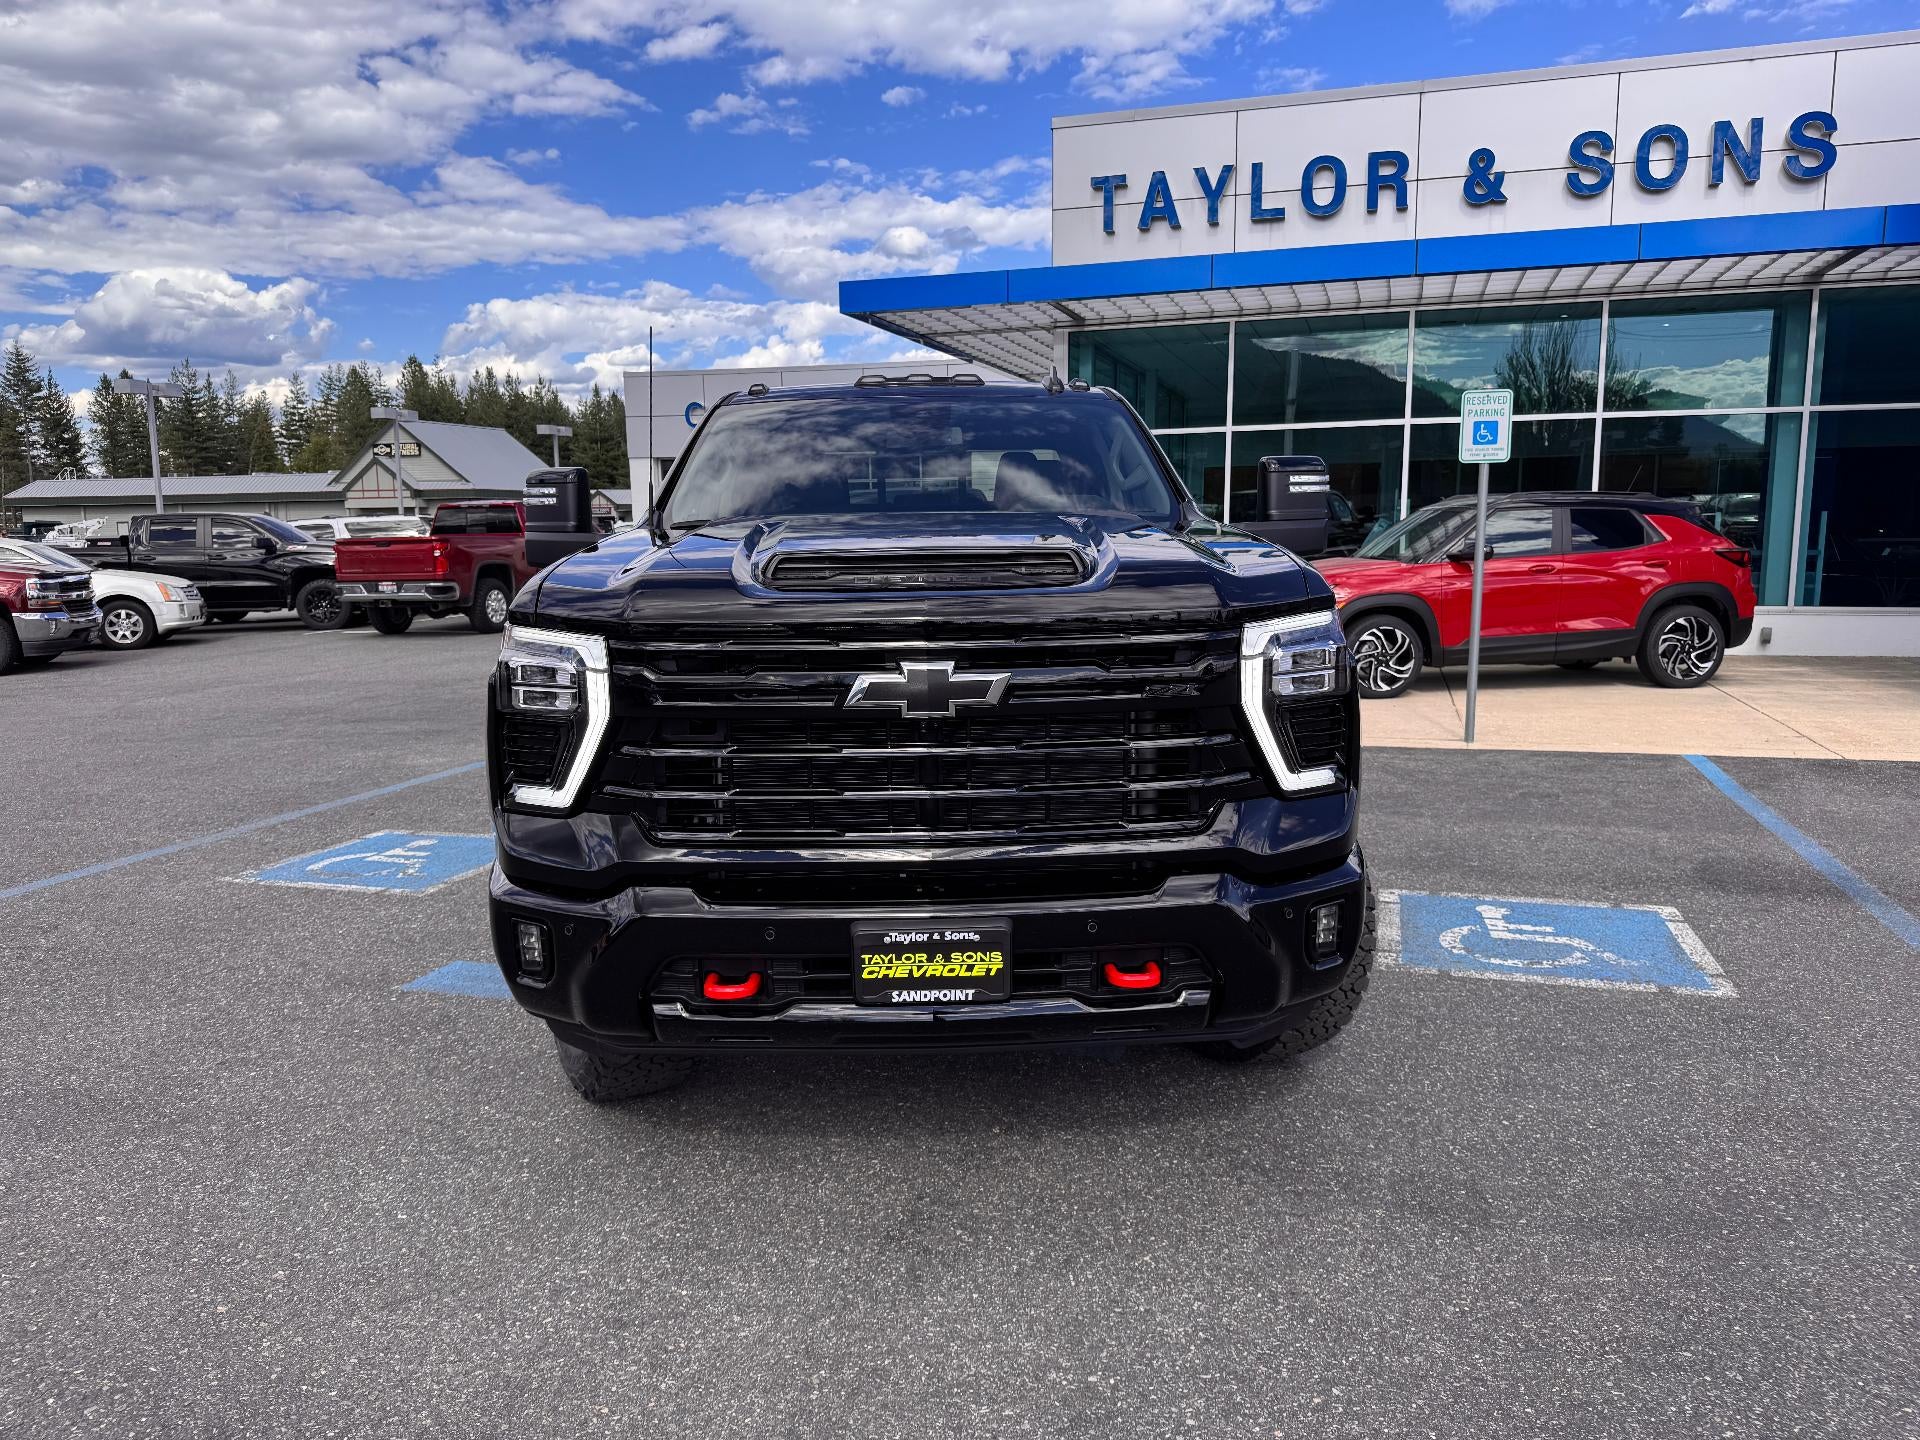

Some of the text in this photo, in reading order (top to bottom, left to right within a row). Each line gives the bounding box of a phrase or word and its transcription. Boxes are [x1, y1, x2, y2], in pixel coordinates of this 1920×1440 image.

[1091, 111, 1838, 235] TAYLOR & SONS
[1467, 396, 1507, 406] RESERVED
[1468, 408, 1505, 418] PARKING
[889, 932, 929, 944] Taylor
[944, 931, 975, 941] Sons
[861, 951, 1003, 965] TAYLOR & SONS
[861, 964, 1004, 979] CHEVROLET
[891, 989, 976, 1003] SANDPOINT
